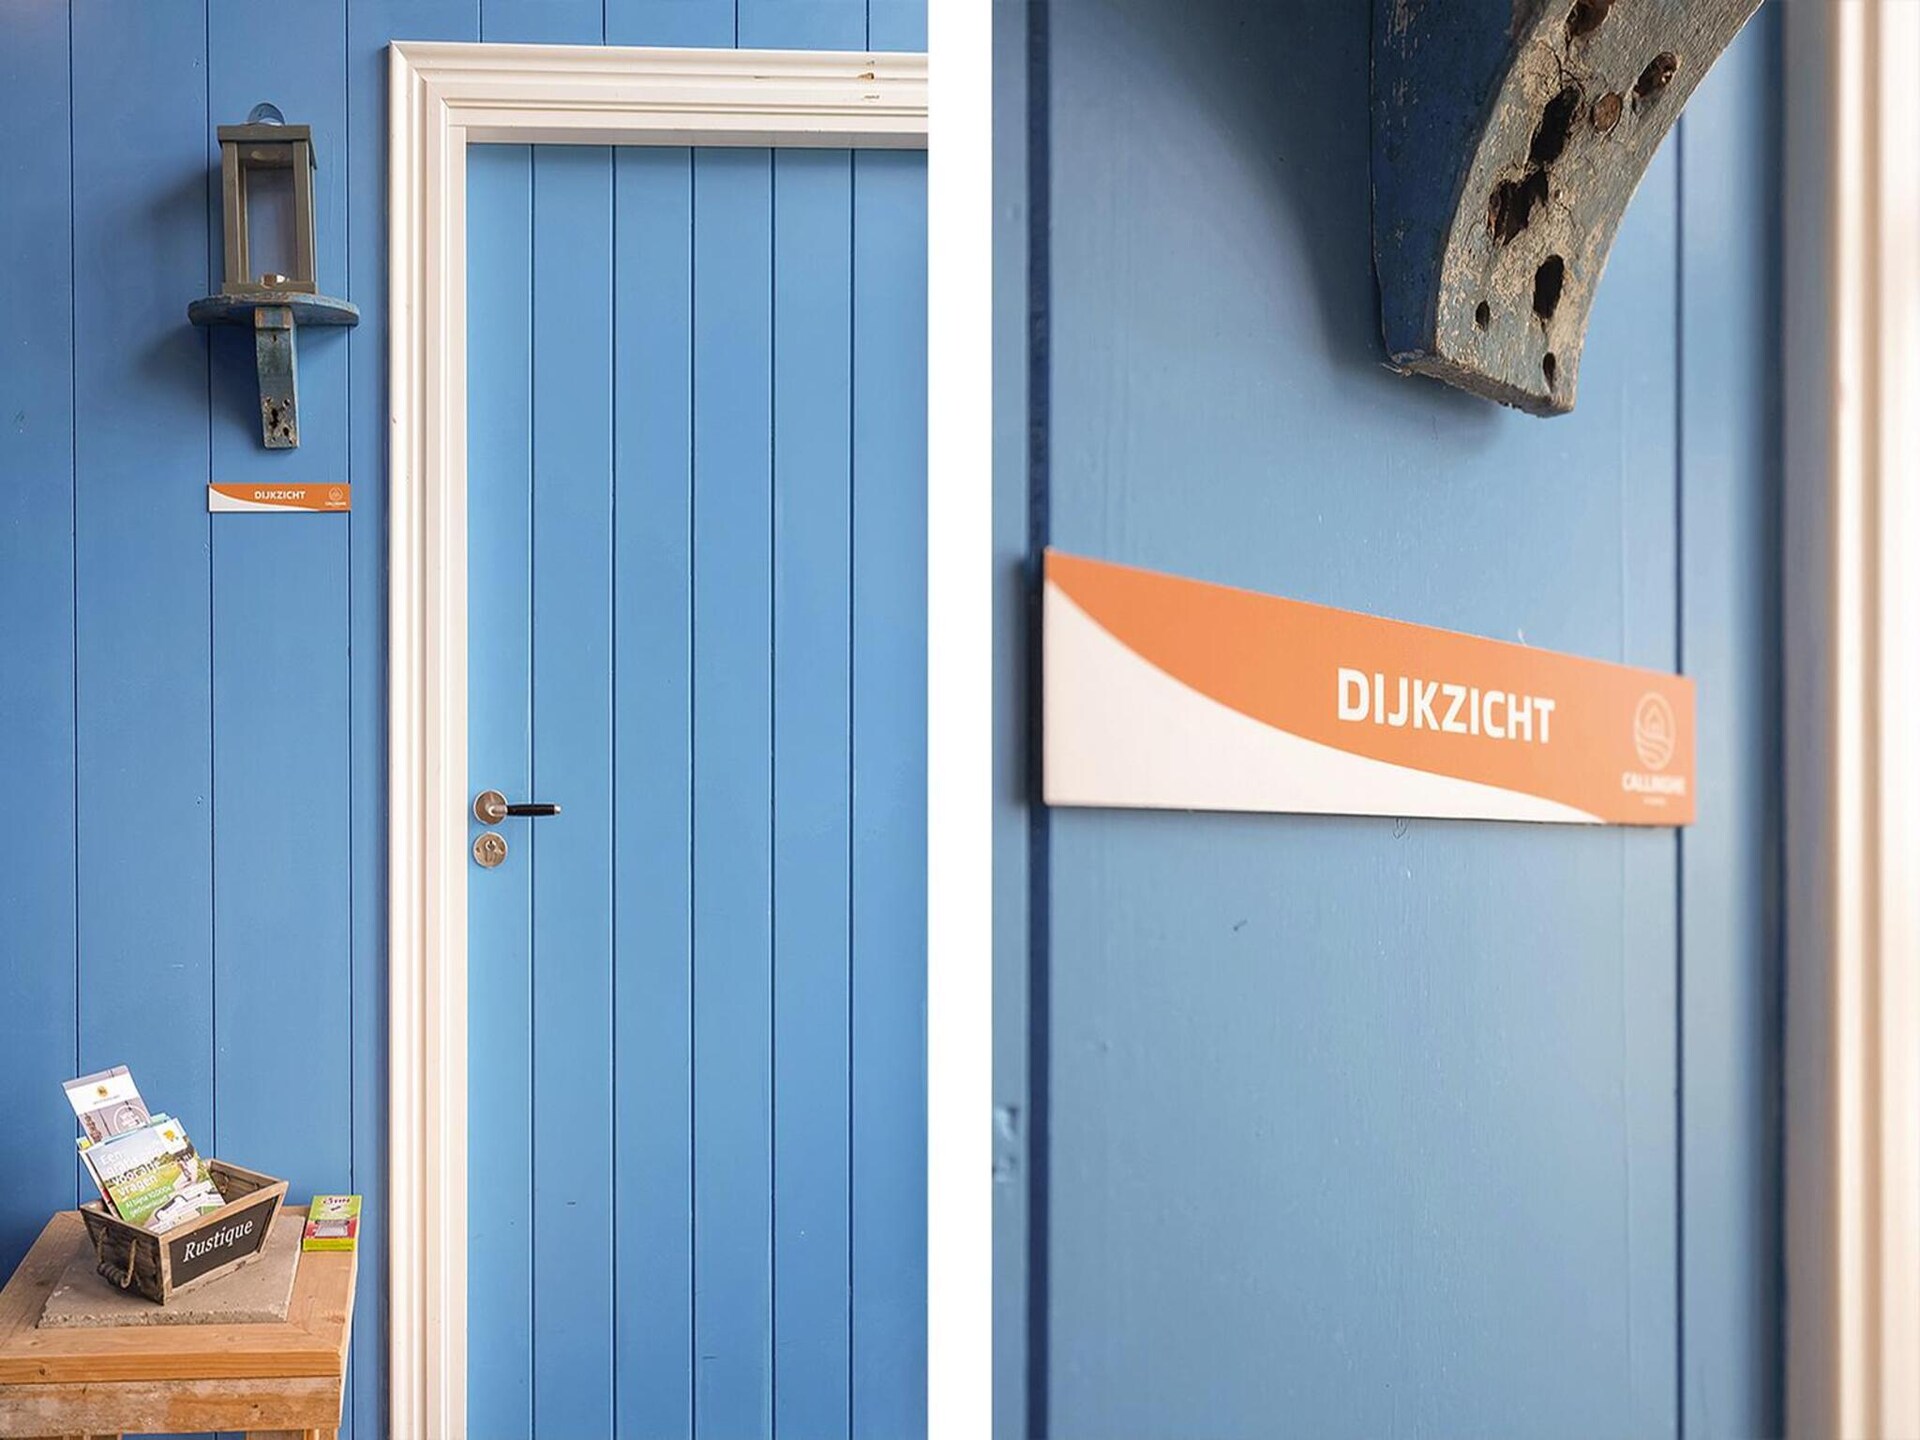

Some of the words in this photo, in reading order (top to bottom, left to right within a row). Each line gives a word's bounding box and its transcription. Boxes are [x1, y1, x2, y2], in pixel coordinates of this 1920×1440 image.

[254, 490, 306, 500] DIJKZICHT
[1337, 667, 1555, 743] DIJKZICHT
[183, 1220, 254, 1263] Rustique
